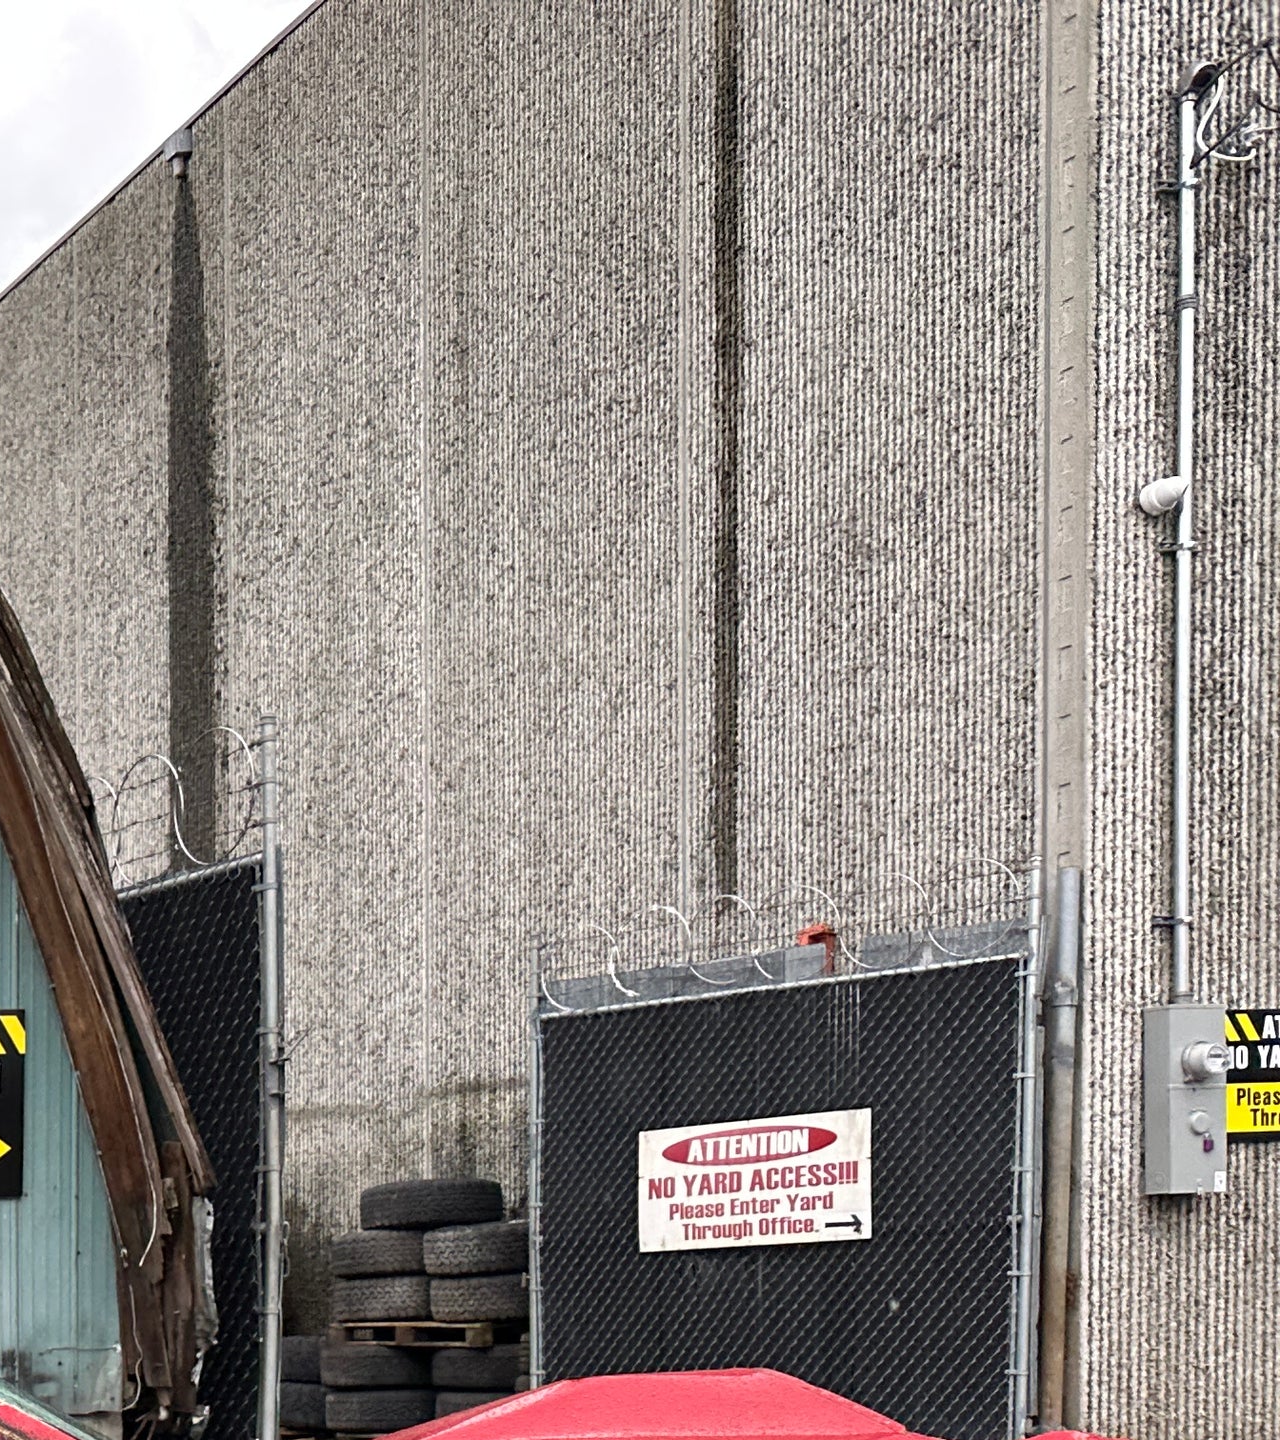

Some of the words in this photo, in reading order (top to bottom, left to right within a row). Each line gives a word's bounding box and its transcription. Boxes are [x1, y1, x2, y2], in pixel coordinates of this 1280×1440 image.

[687, 1128, 810, 1164] ATTENTION
[648, 1176, 676, 1200] NO
[682, 1170, 742, 1197] YARD
[749, 1160, 860, 1192] ACCESS!!!
[669, 1200, 725, 1221] Please
[730, 1197, 781, 1217] Enter
[786, 1191, 834, 1214] Yard
[682, 1219, 753, 1241] Through
